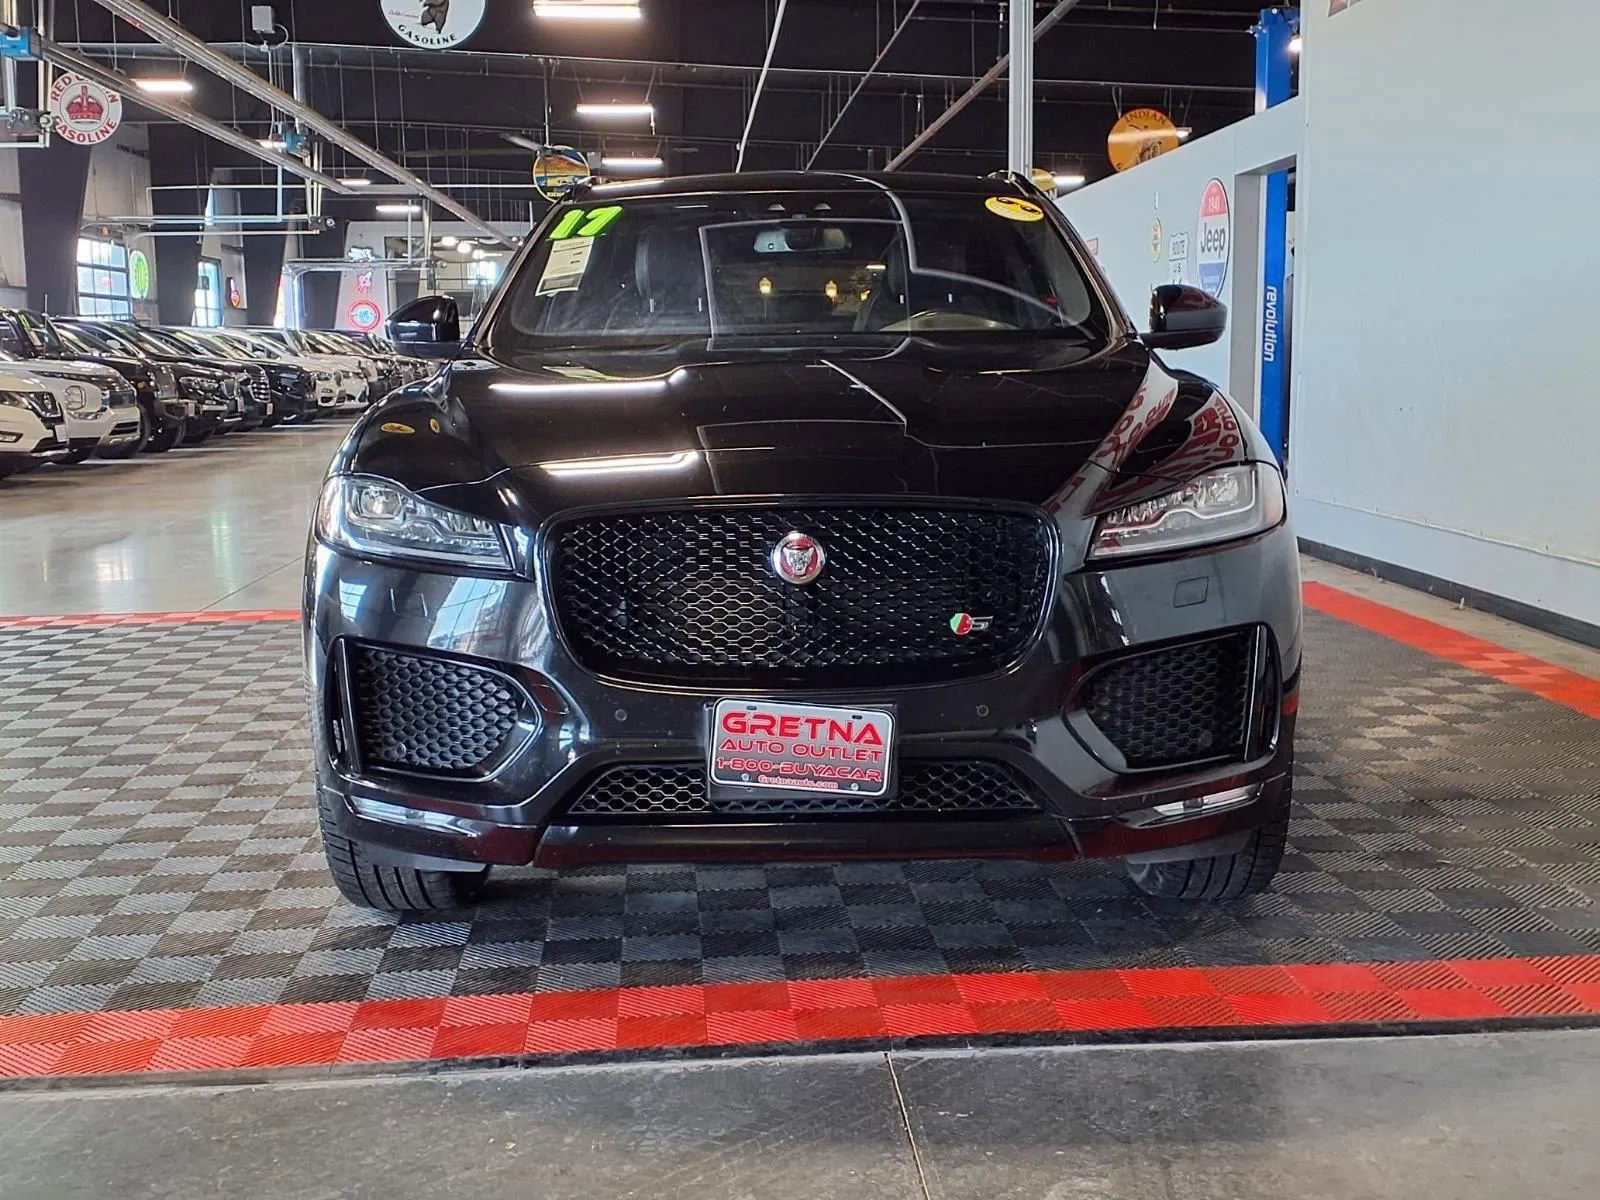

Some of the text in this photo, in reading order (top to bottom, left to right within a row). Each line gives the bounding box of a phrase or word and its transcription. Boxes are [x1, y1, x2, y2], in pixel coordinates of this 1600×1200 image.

[398, 24, 457, 45] GASOLINE
[51, 76, 72, 102] RED
[1125, 111, 1167, 125] INDIAN
[549, 205, 624, 241] 17
[1201, 221, 1226, 258] Jeep
[1264, 285, 1278, 362] revolution
[722, 711, 883, 746] GRETNA
[719, 738, 884, 763] AUTO OUTLET
[716, 757, 882, 782] 1-800-BUYACAR
